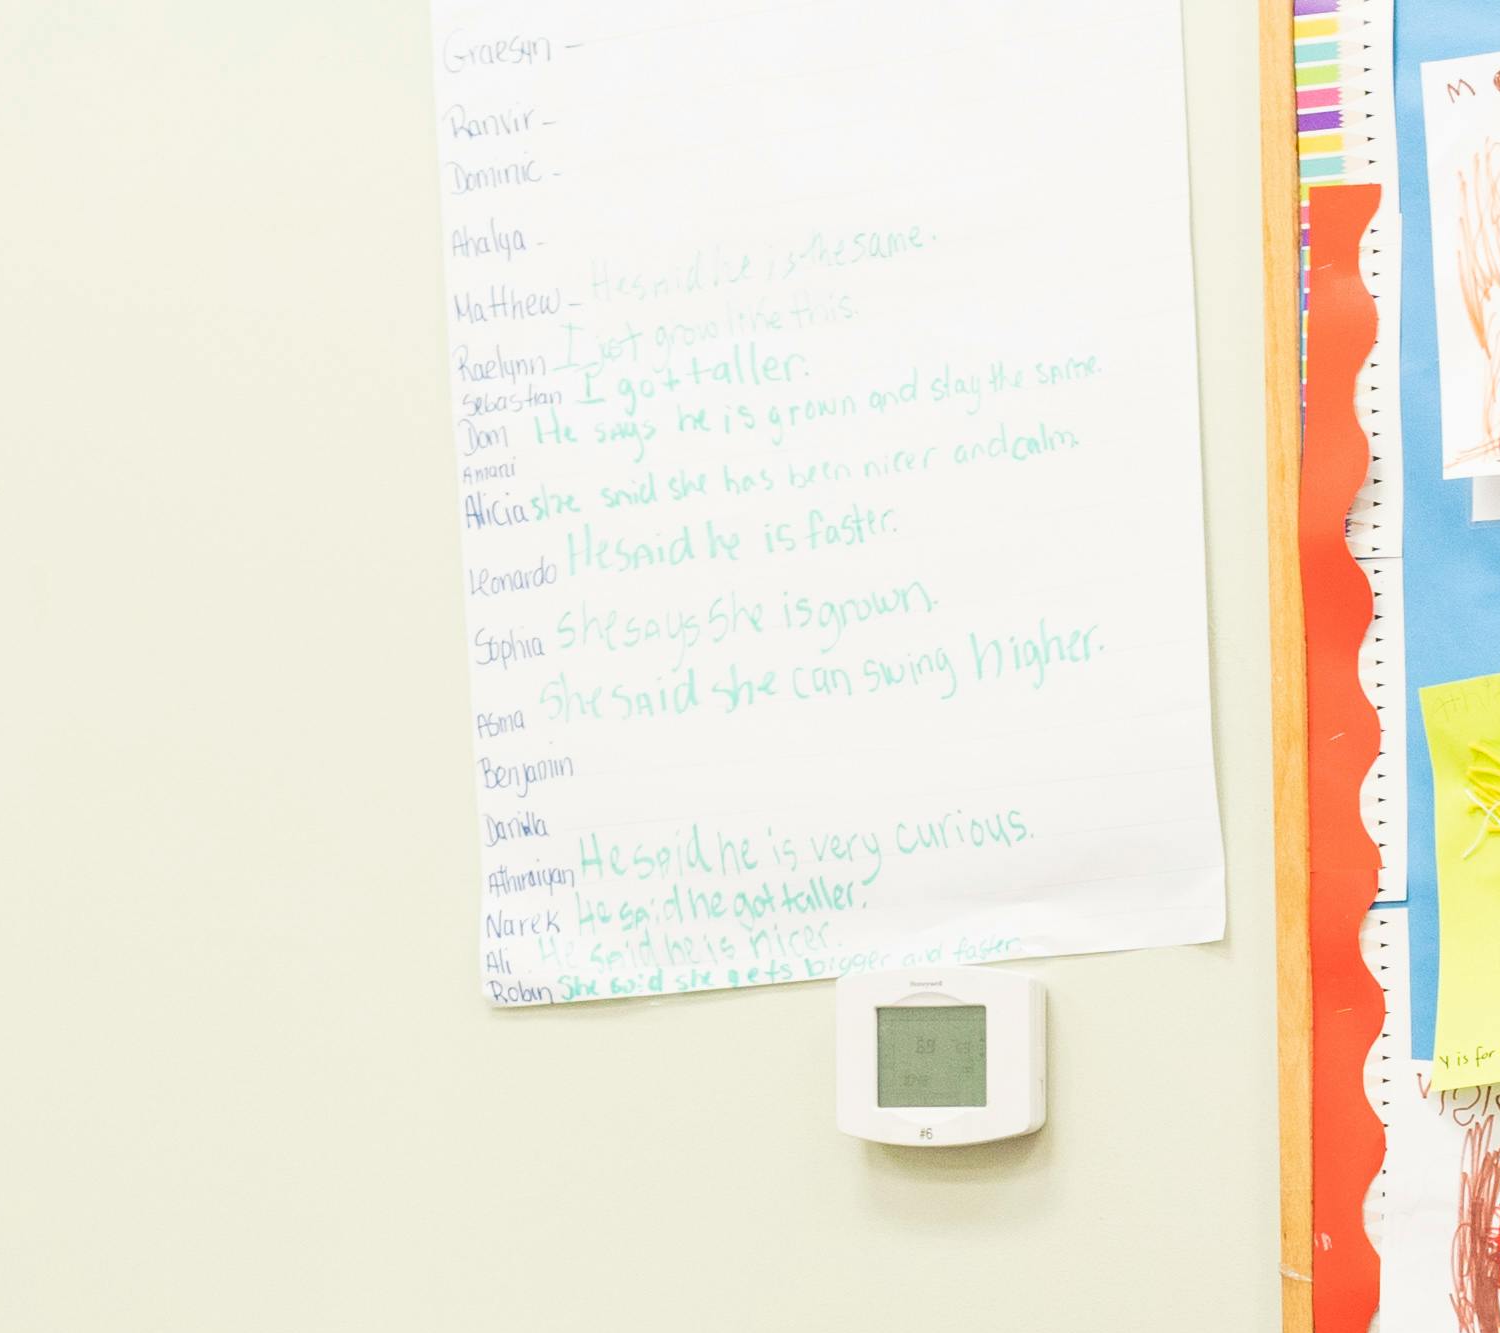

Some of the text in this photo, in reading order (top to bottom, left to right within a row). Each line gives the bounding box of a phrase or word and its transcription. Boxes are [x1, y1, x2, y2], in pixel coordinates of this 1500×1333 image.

[473, 627, 546, 669] Sophia
[793, 660, 853, 697] can
[864, 644, 957, 699] swing
[481, 751, 573, 797] Benjamin
[772, 832, 798, 874] is
[812, 829, 882, 887] very
[896, 808, 1035, 855] curious.
[919, 1128, 933, 1140] #6
